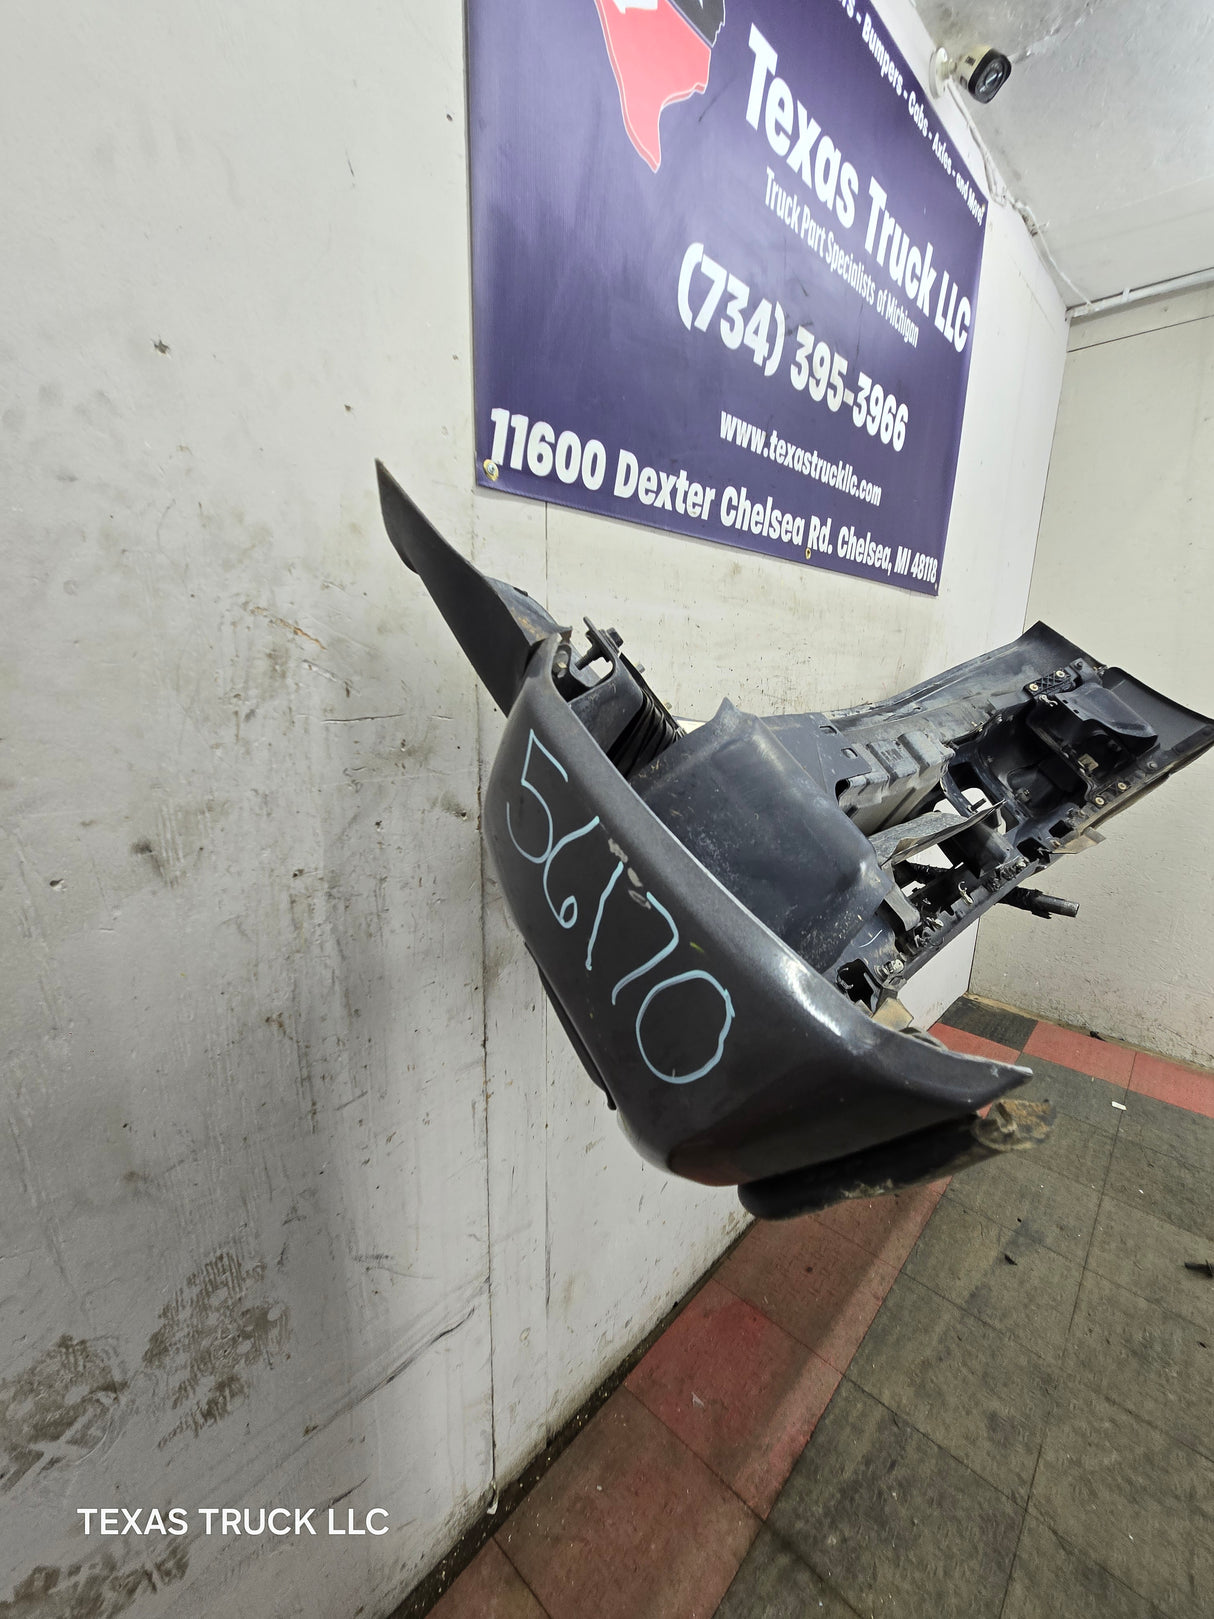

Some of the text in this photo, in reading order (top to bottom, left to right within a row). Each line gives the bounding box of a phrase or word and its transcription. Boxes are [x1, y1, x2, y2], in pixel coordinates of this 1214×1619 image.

[746, 23, 972, 353] Texas Truck LLC
[862, 13, 904, 96] Bumpers
[908, 91, 929, 137] Cabs
[932, 132, 952, 175] Axles
[956, 172, 970, 200] and
[677, 241, 909, 452] (734) 395-3966
[765, 166, 920, 349] Truck Part Specialists of Michigan
[490, 407, 938, 584] 11600 Dexter Chelsea Rd. Chelsea, MI 48118
[720, 410, 882, 507] www.texastruckllc.com
